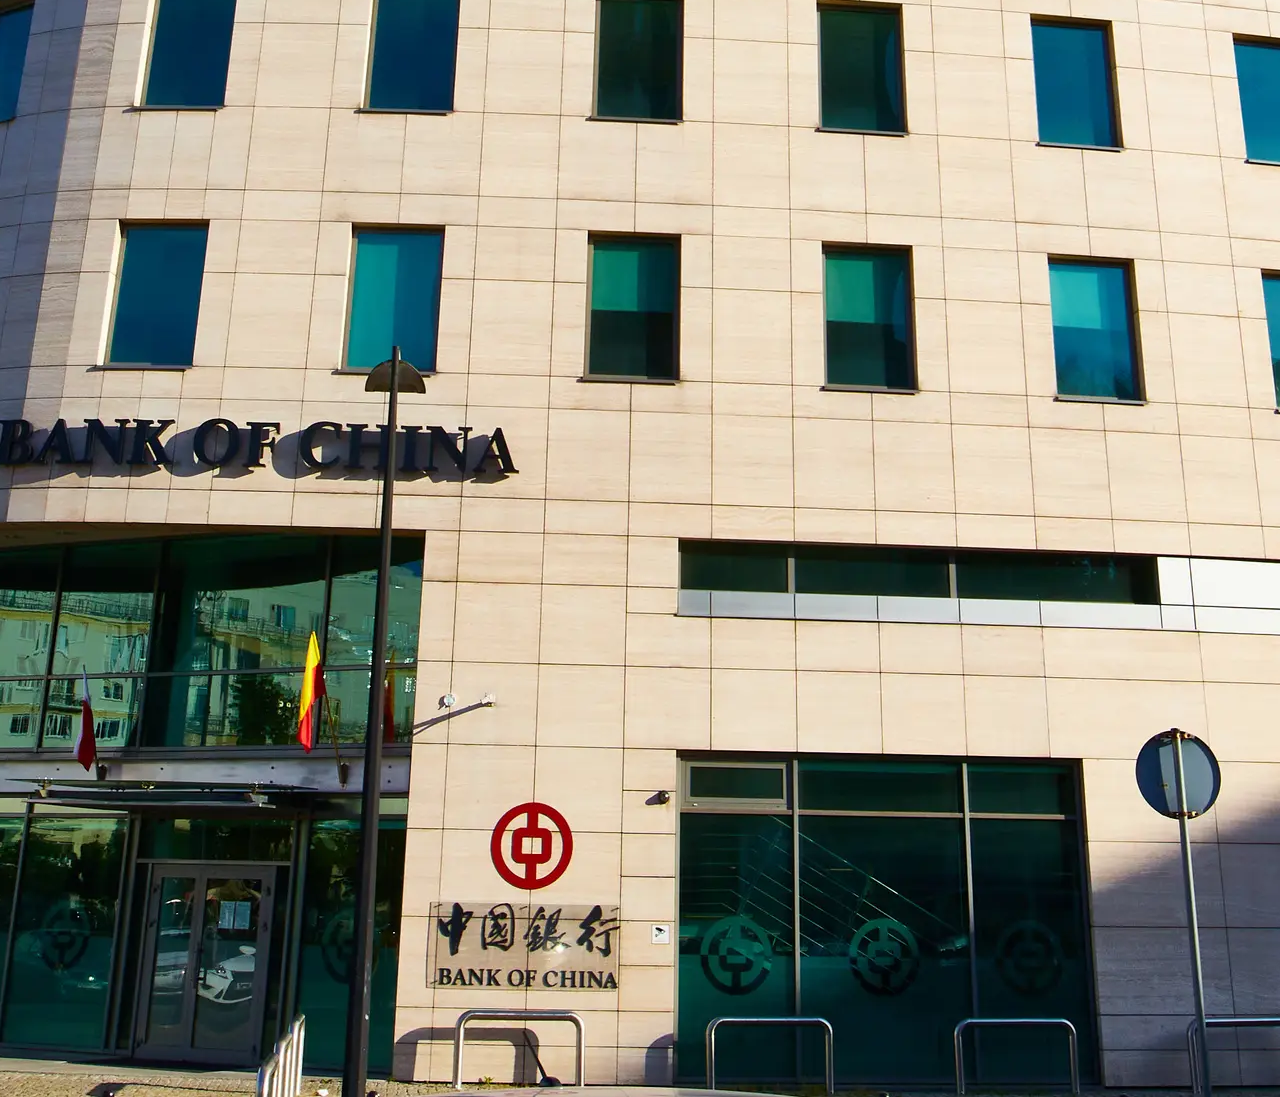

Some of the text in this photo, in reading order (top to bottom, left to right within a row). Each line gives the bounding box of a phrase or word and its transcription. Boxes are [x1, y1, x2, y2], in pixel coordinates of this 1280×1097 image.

[193, 418, 281, 469] OF
[300, 421, 519, 475] CHINA
[437, 902, 620, 958] 中國銀行
[437, 968, 618, 989] BANK OF CHINA
